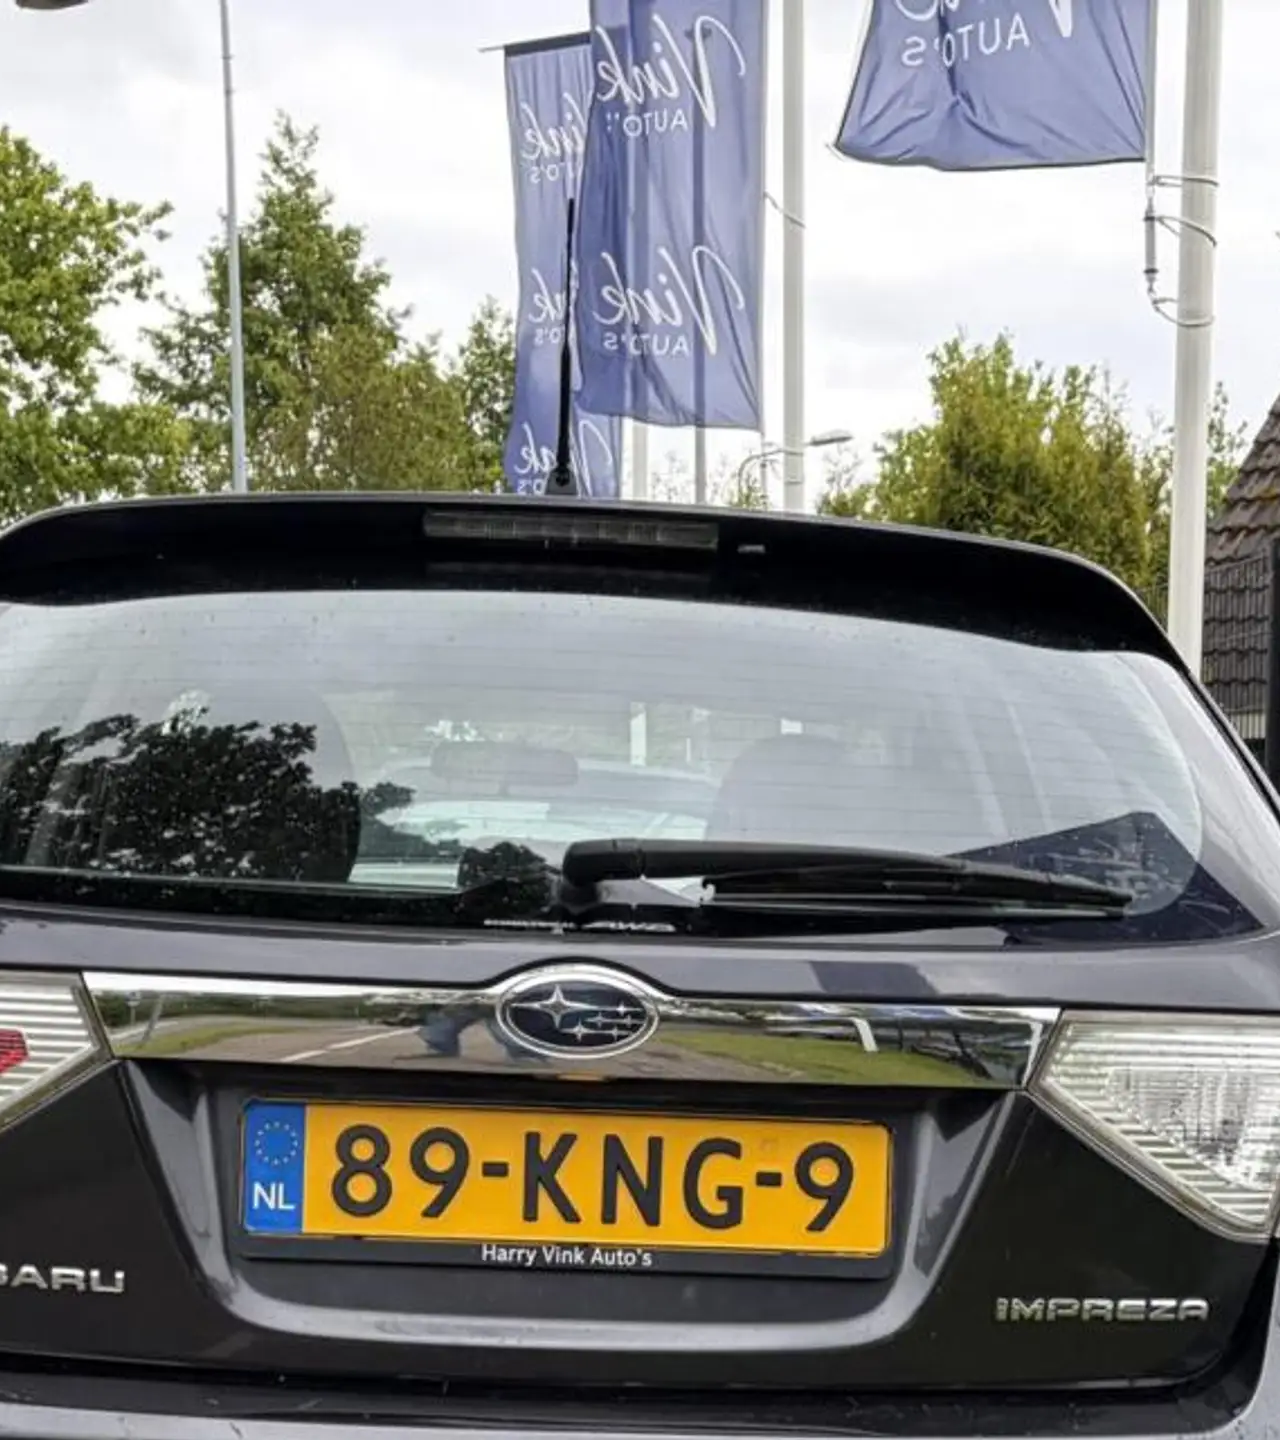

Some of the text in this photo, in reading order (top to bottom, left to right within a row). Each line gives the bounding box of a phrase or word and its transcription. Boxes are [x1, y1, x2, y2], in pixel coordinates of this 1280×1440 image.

[331, 1123, 855, 1233] 89-KNG-9
[252, 1181, 297, 1211] NL
[481, 1243, 653, 1267] Harry Vink Auto's
[995, 1297, 1210, 1322] IMPREZA
